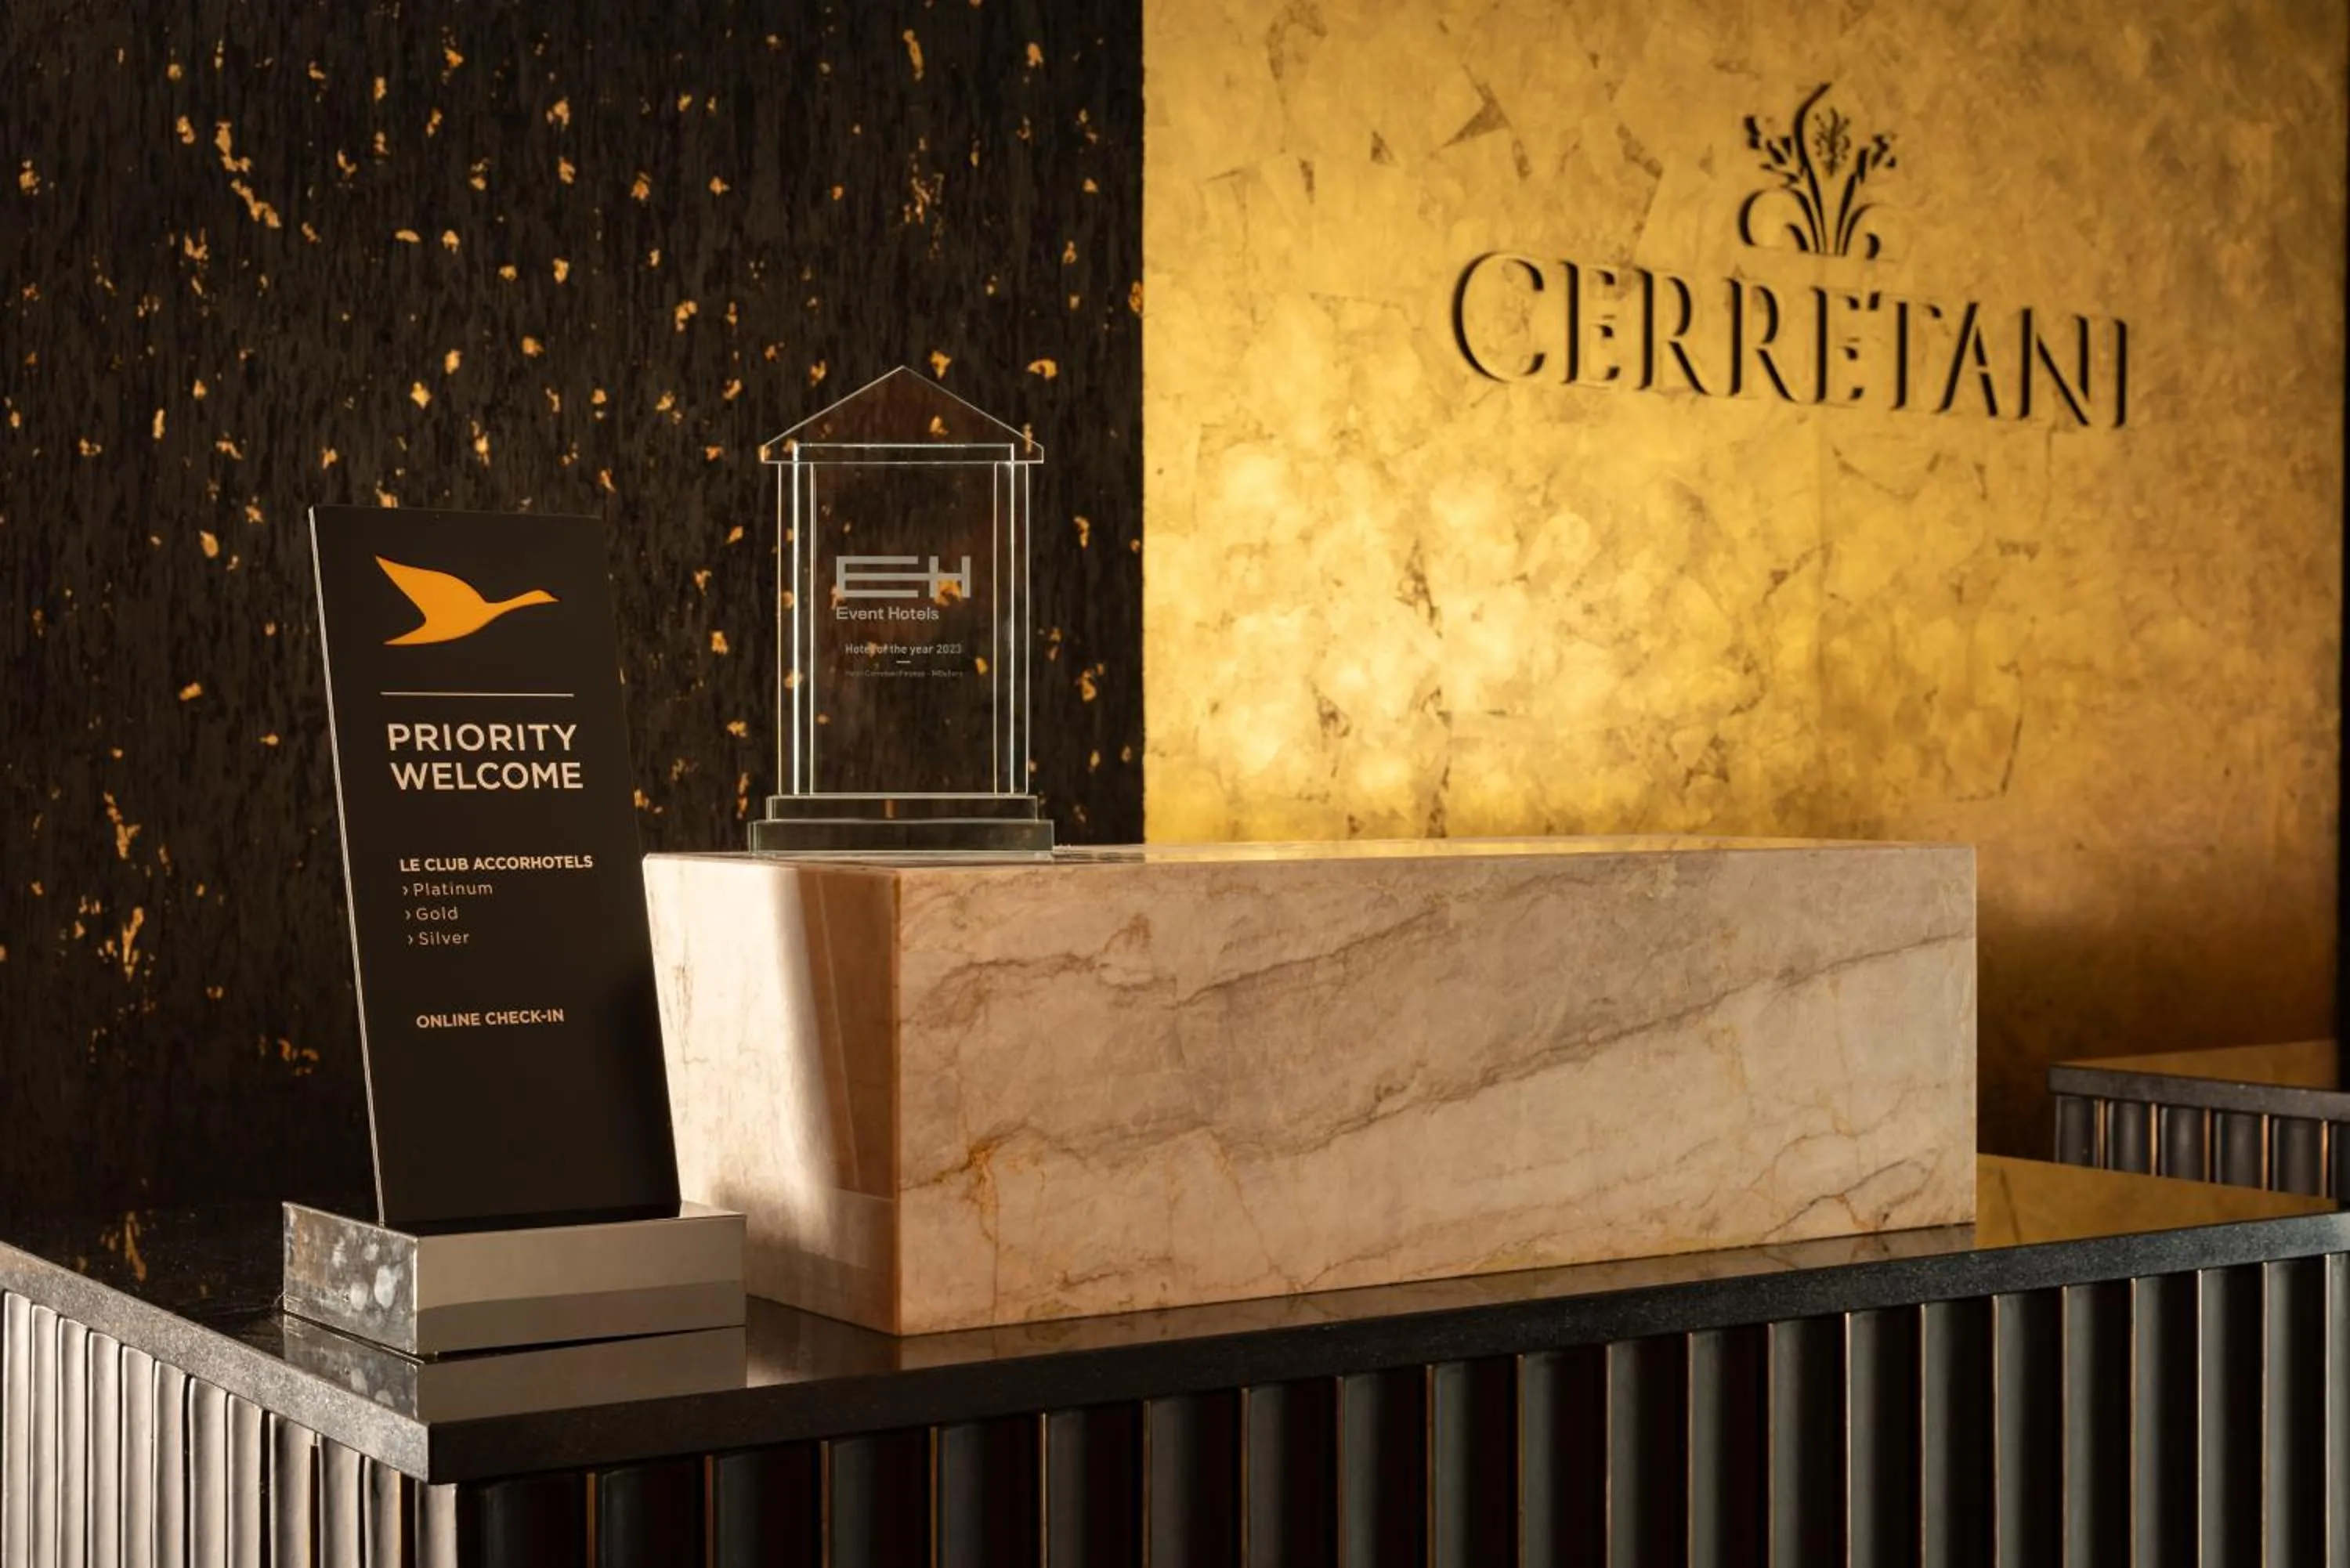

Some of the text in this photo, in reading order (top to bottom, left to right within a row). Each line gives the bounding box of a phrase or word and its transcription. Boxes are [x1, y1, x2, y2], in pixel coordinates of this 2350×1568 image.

[1451, 251, 2128, 428] CERRETANI
[836, 606, 939, 620] Event Hotels
[877, 644, 888, 653] of
[889, 643, 906, 654] the
[909, 644, 934, 656] year
[936, 643, 962, 654] 2023
[388, 723, 577, 751] PRIORITY
[390, 761, 584, 790] WELCOME
[400, 855, 594, 872] LE CLUB ACCORHOTELS
[413, 882, 494, 897] Platinum
[416, 906, 458, 921] Gold
[418, 930, 470, 945] Silver
[416, 1009, 565, 1028] ONLINE CHECK-IN
